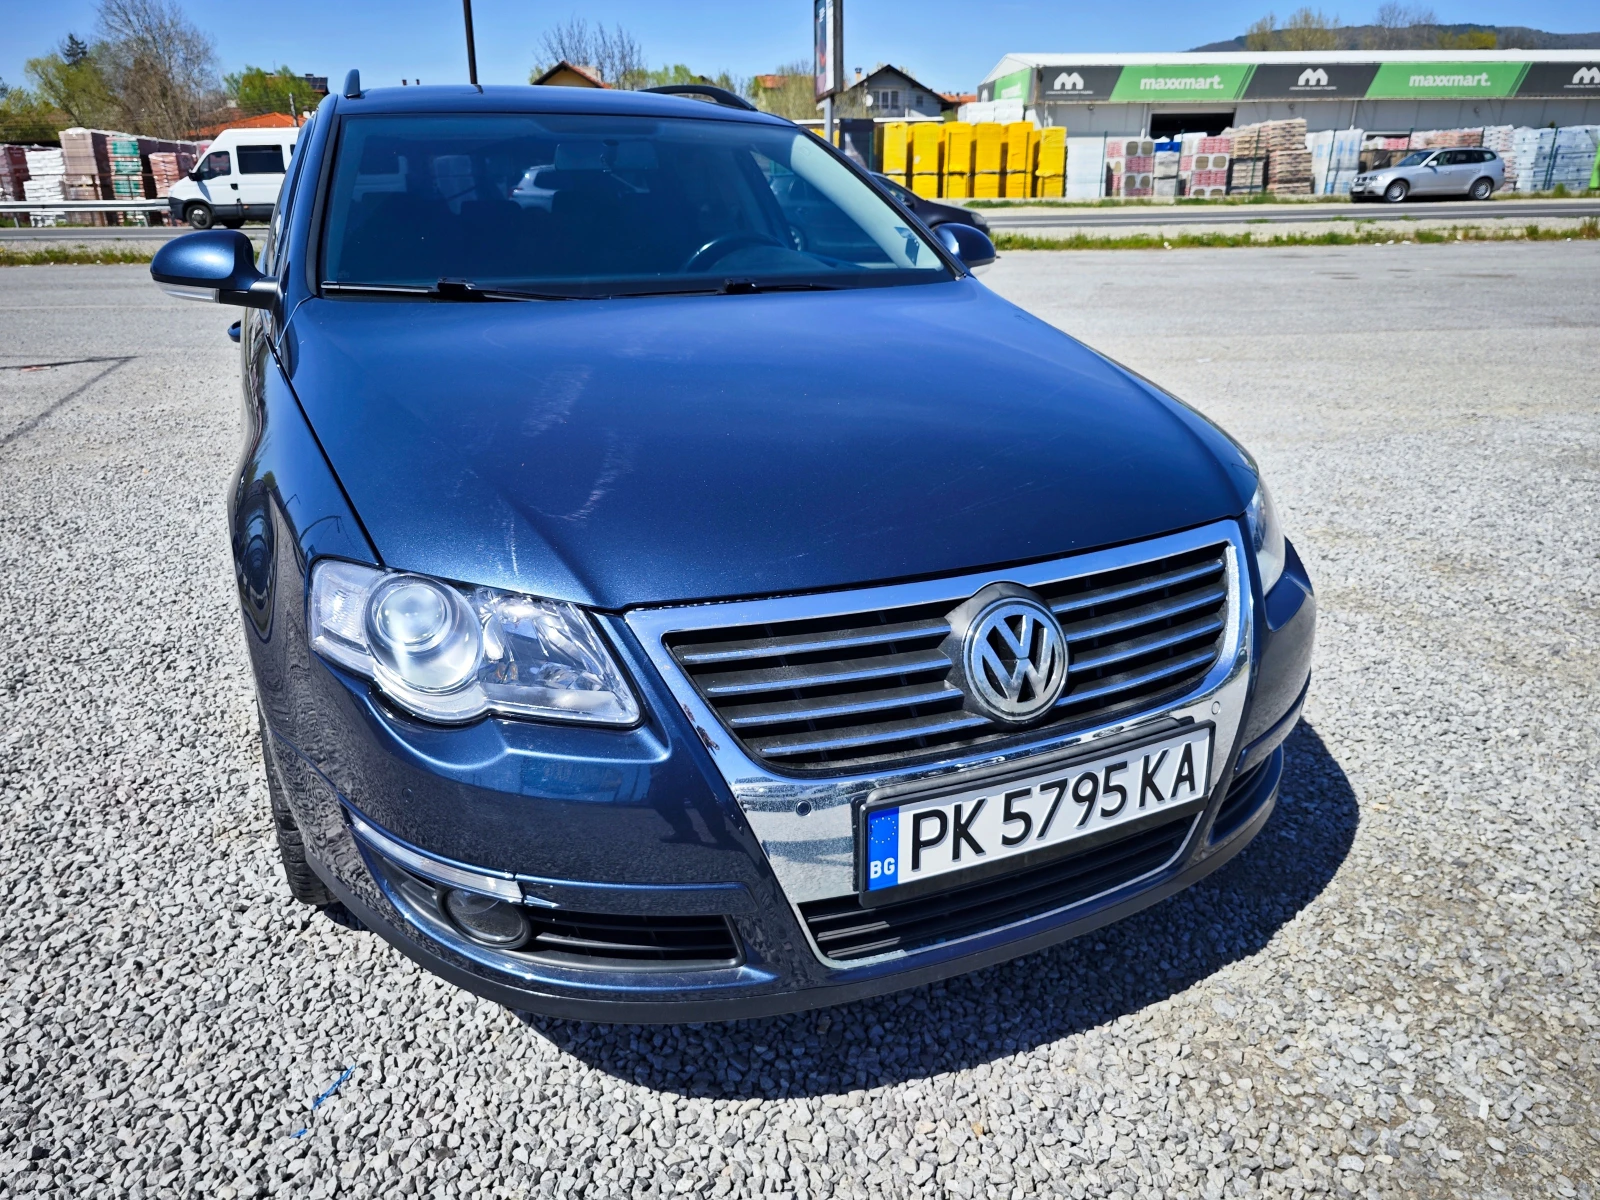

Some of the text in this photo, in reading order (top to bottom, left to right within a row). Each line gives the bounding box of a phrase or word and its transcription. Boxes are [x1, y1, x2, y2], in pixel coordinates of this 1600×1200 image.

[969, 604, 1063, 713] VW
[911, 742, 1197, 872] PK 5795 KA
[869, 857, 896, 879] BG
